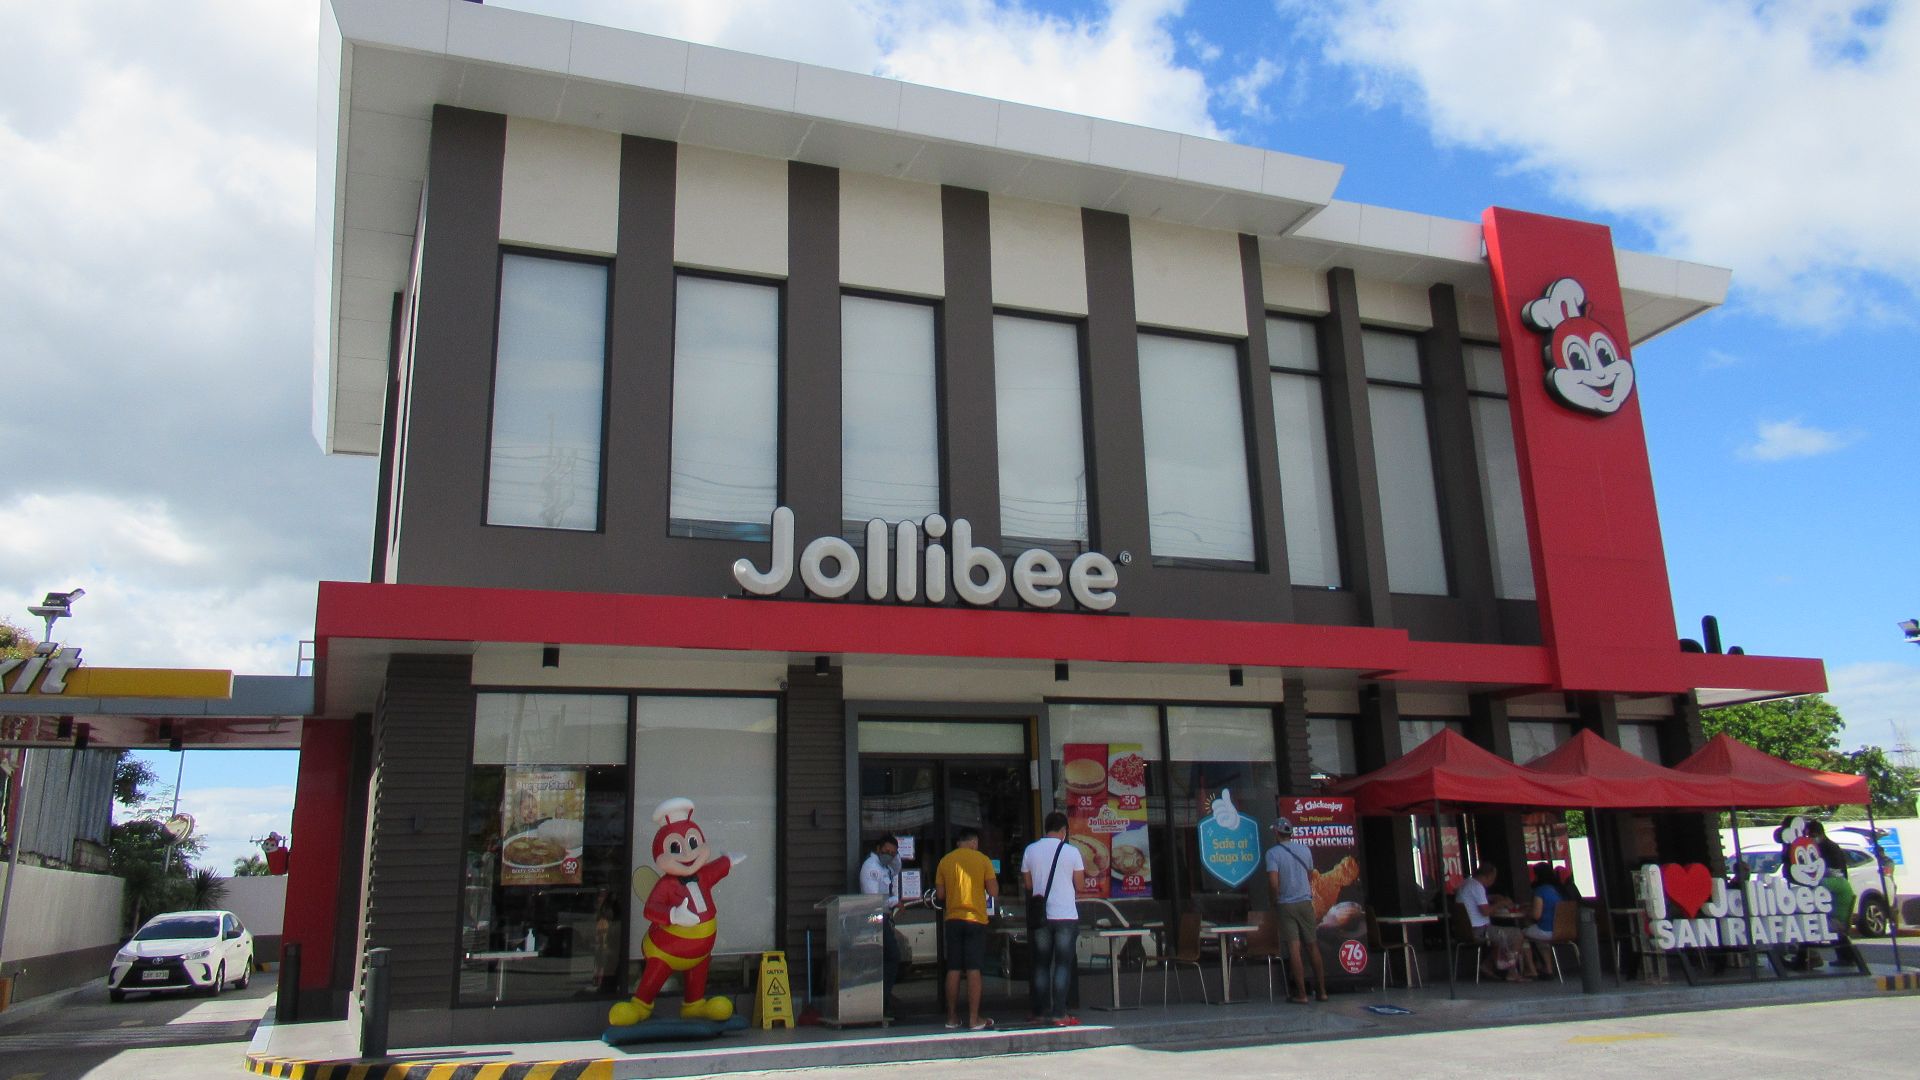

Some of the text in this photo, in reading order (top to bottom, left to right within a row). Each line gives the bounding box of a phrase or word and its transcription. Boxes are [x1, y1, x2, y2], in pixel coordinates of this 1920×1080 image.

[733, 506, 1118, 611] Jollibee
[1304, 800, 1343, 812] Chickenjoy
[1292, 825, 1354, 837] EST-TASTING
[1212, 838, 1249, 849] Safe at
[1315, 836, 1355, 847] CHICKEN
[1210, 851, 1239, 865] alaga
[1655, 913, 1839, 950] SAN RAFAEL
